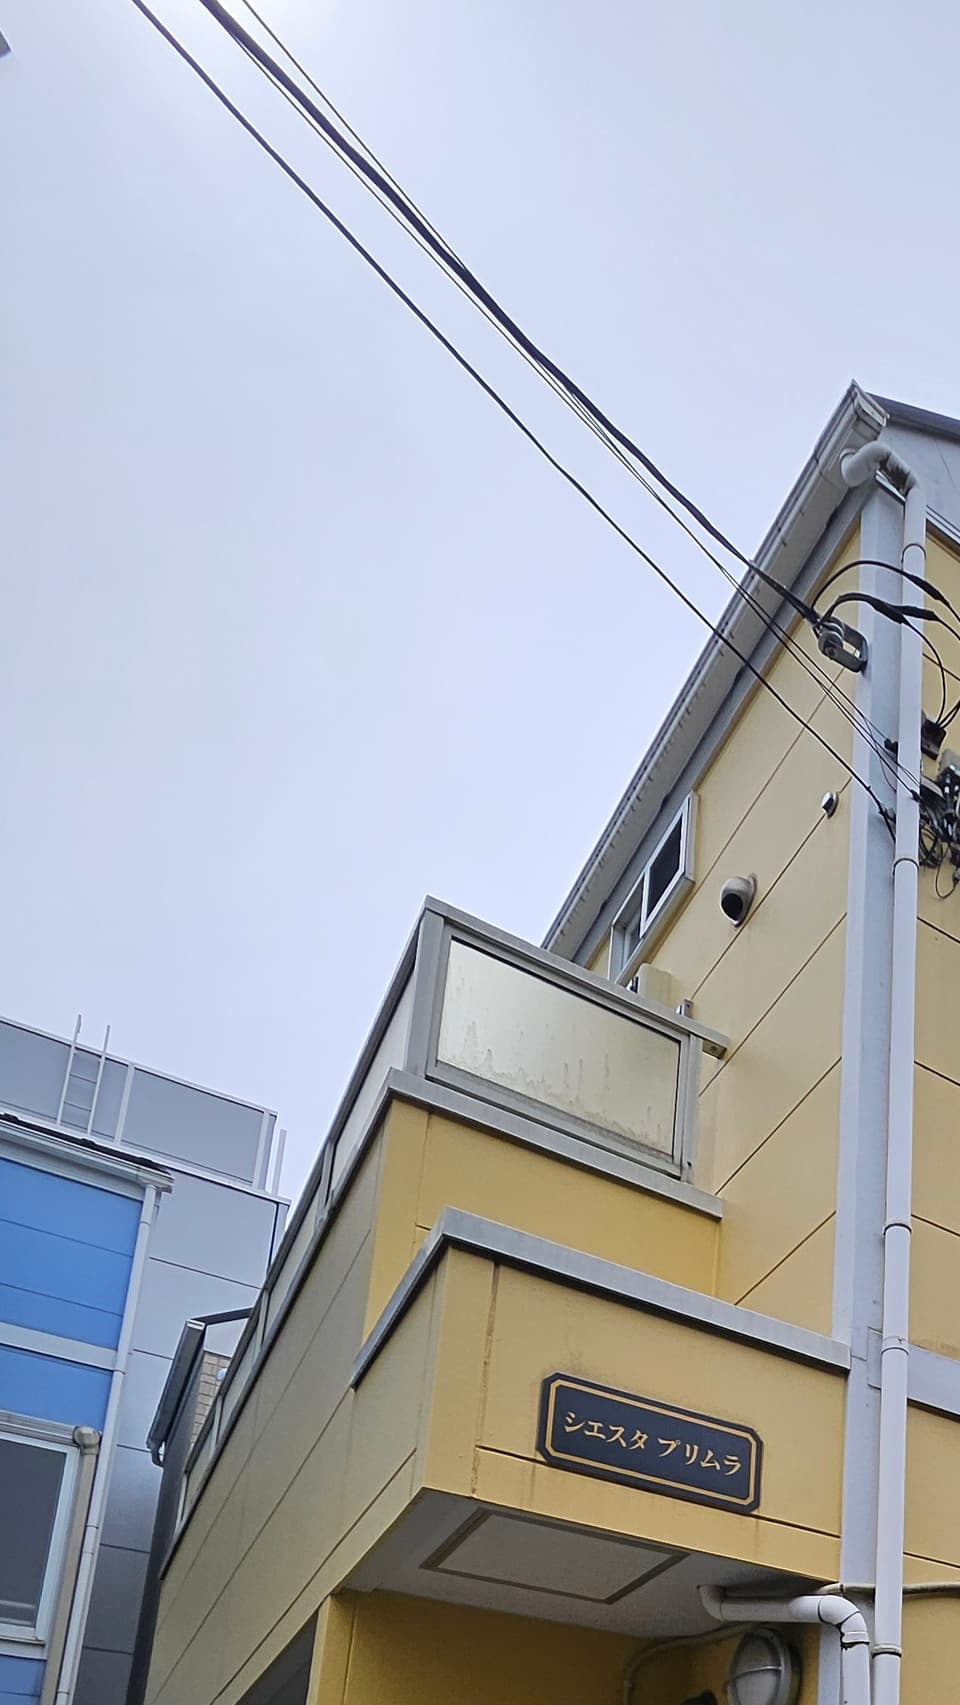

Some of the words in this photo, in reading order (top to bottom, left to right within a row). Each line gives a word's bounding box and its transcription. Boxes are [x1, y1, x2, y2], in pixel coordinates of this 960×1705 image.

[564, 1411, 648, 1450] シエスタ
[657, 1437, 741, 1475] プリムラ
